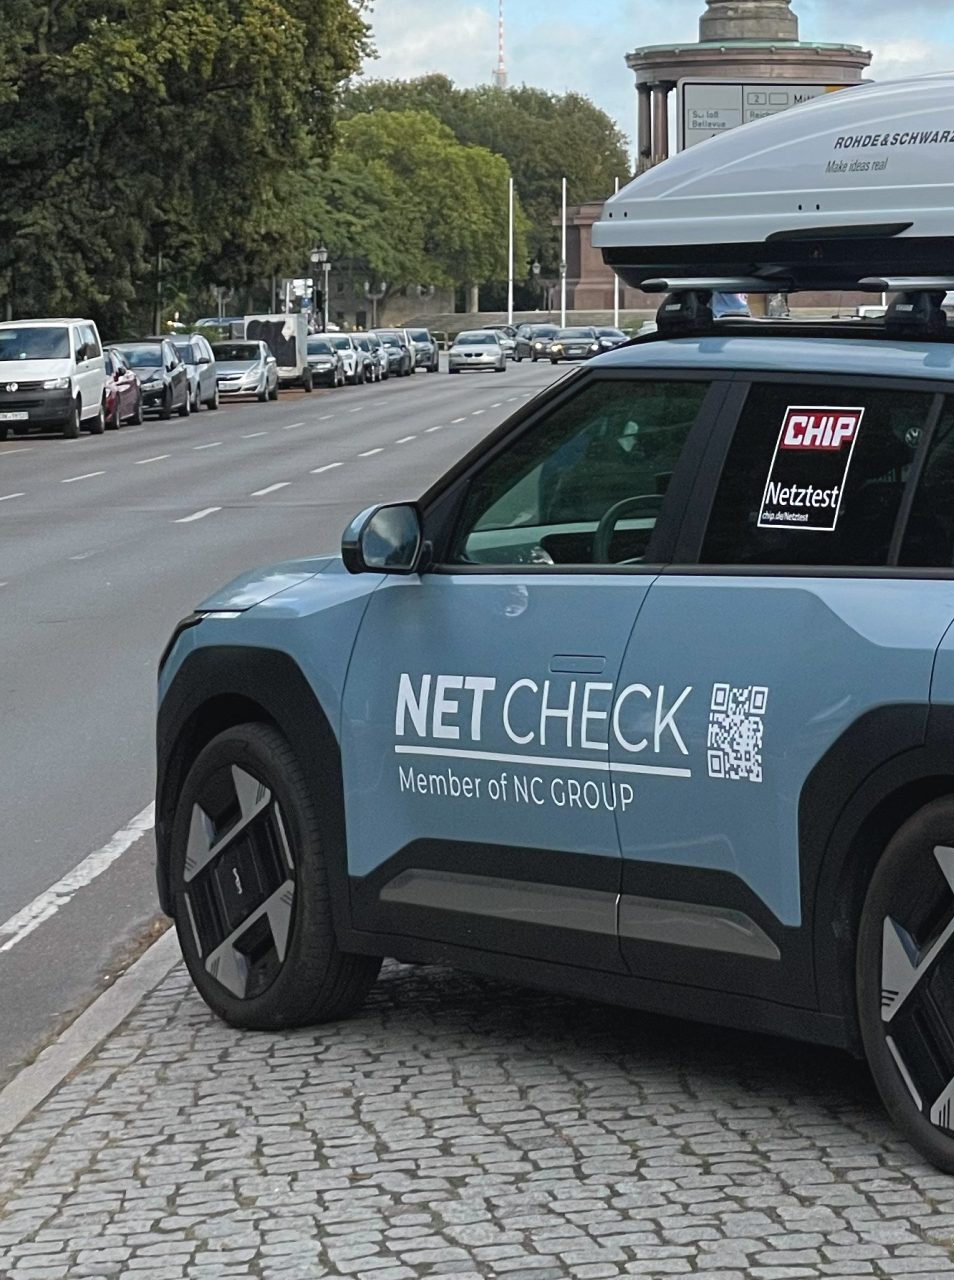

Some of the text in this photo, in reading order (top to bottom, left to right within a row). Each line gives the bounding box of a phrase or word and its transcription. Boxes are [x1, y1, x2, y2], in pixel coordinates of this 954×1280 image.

[754, 95, 760, 103] 2
[692, 120, 726, 128] Bellevue
[825, 157, 888, 173] Make ideas real
[784, 415, 856, 446] CHIP
[765, 481, 839, 508] Netztest
[399, 765, 634, 812] Member of NC GROUP
